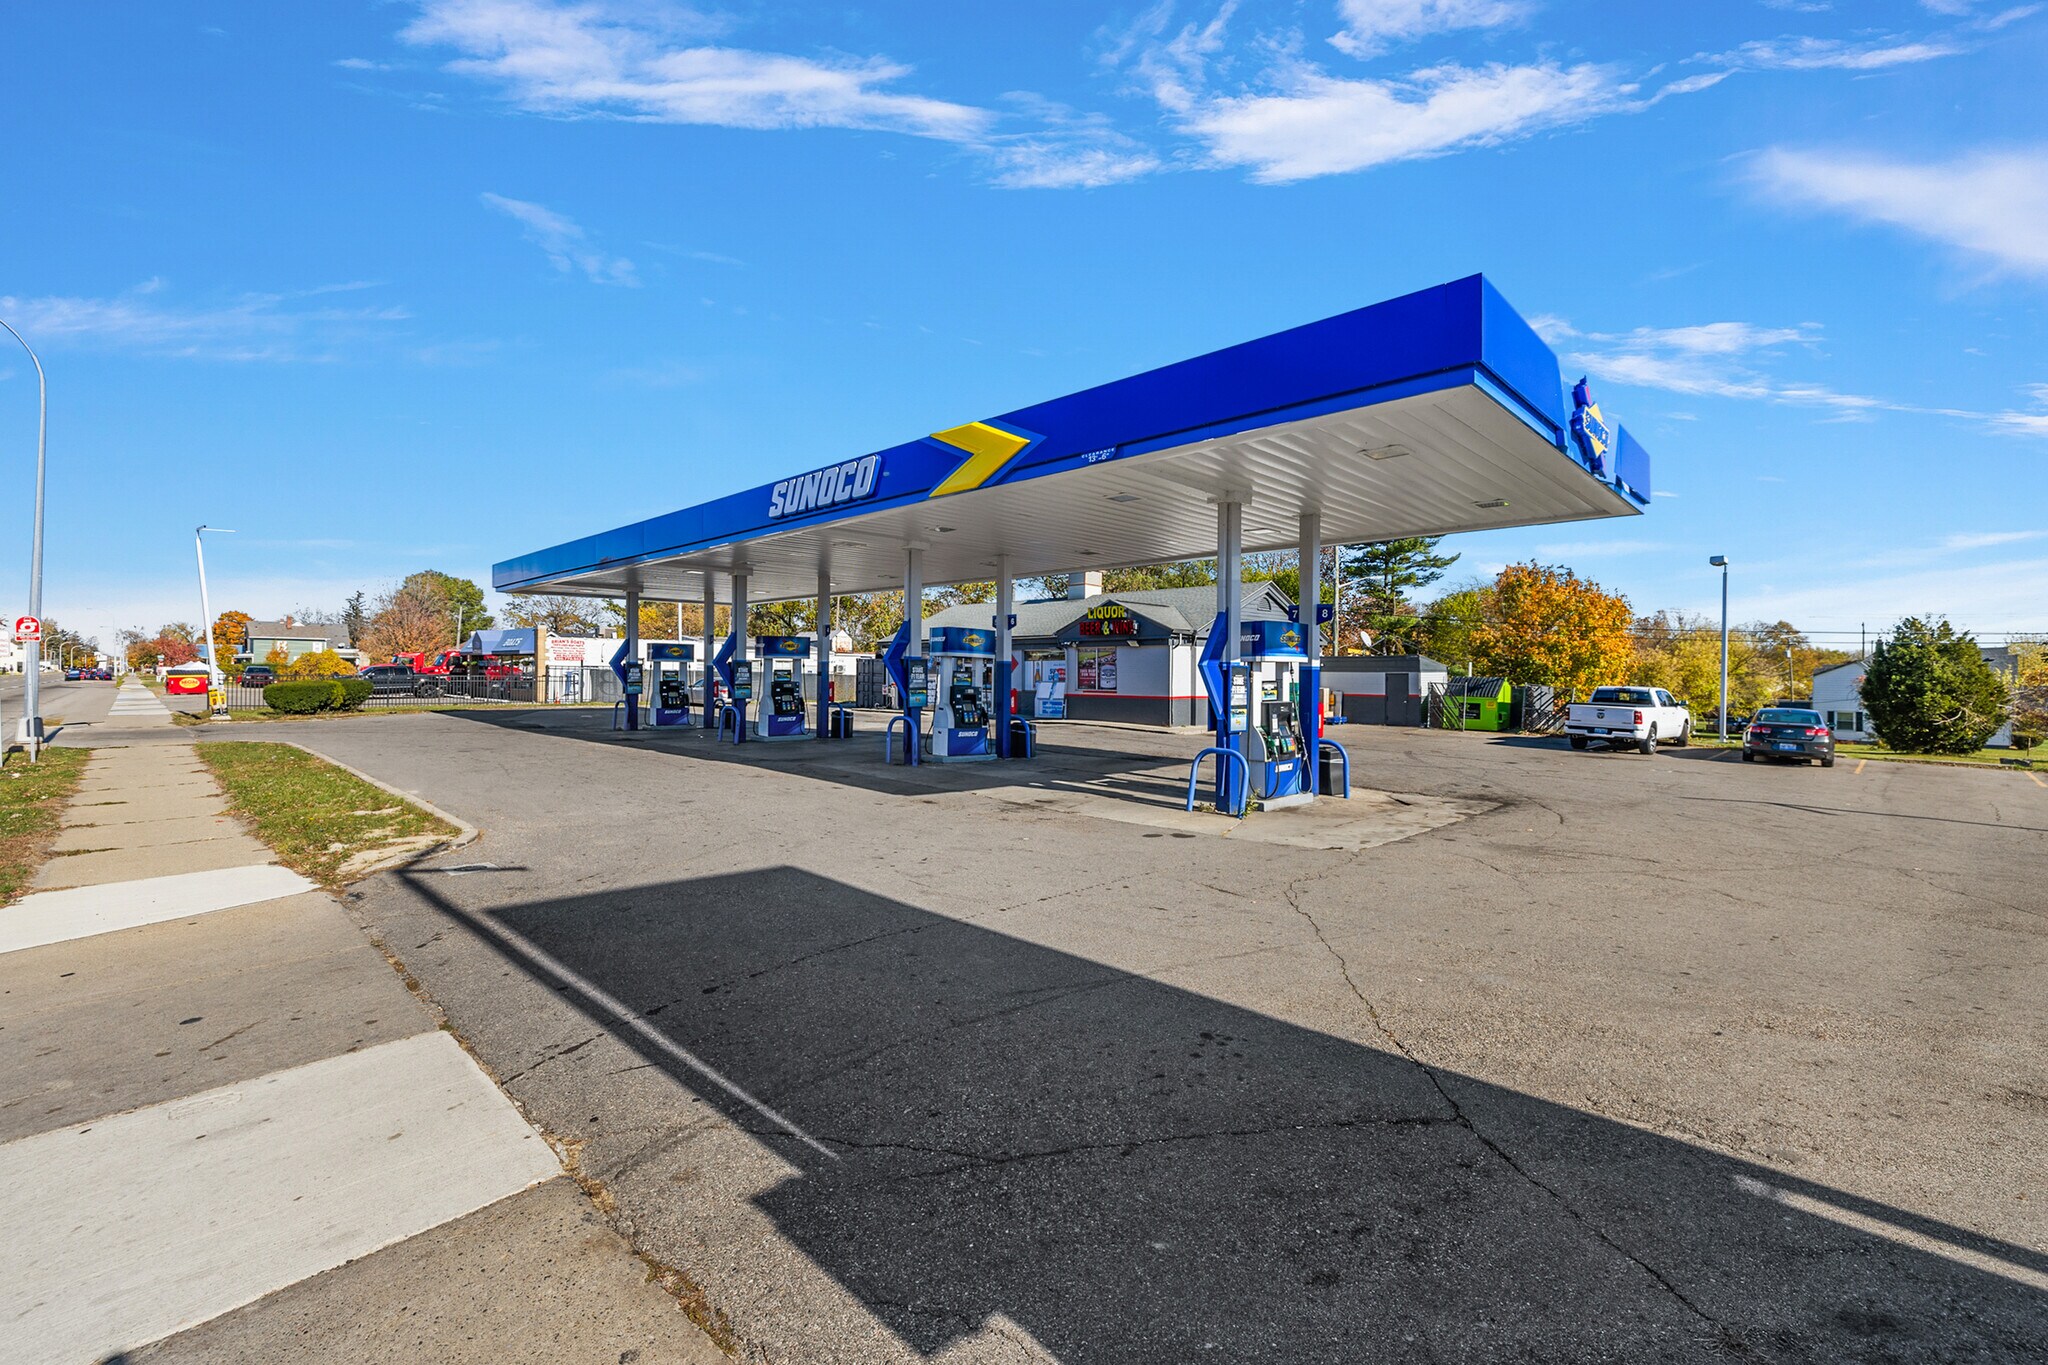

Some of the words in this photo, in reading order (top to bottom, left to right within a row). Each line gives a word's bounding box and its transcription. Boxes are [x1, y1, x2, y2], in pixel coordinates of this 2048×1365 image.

[768, 455, 880, 519] SUNOCO
[1087, 605, 1125, 619] LIQUOR
[1292, 610, 1298, 619] 7
[1322, 609, 1329, 619] 8
[1079, 620, 1101, 635] BEER
[1103, 620, 1110, 635] &
